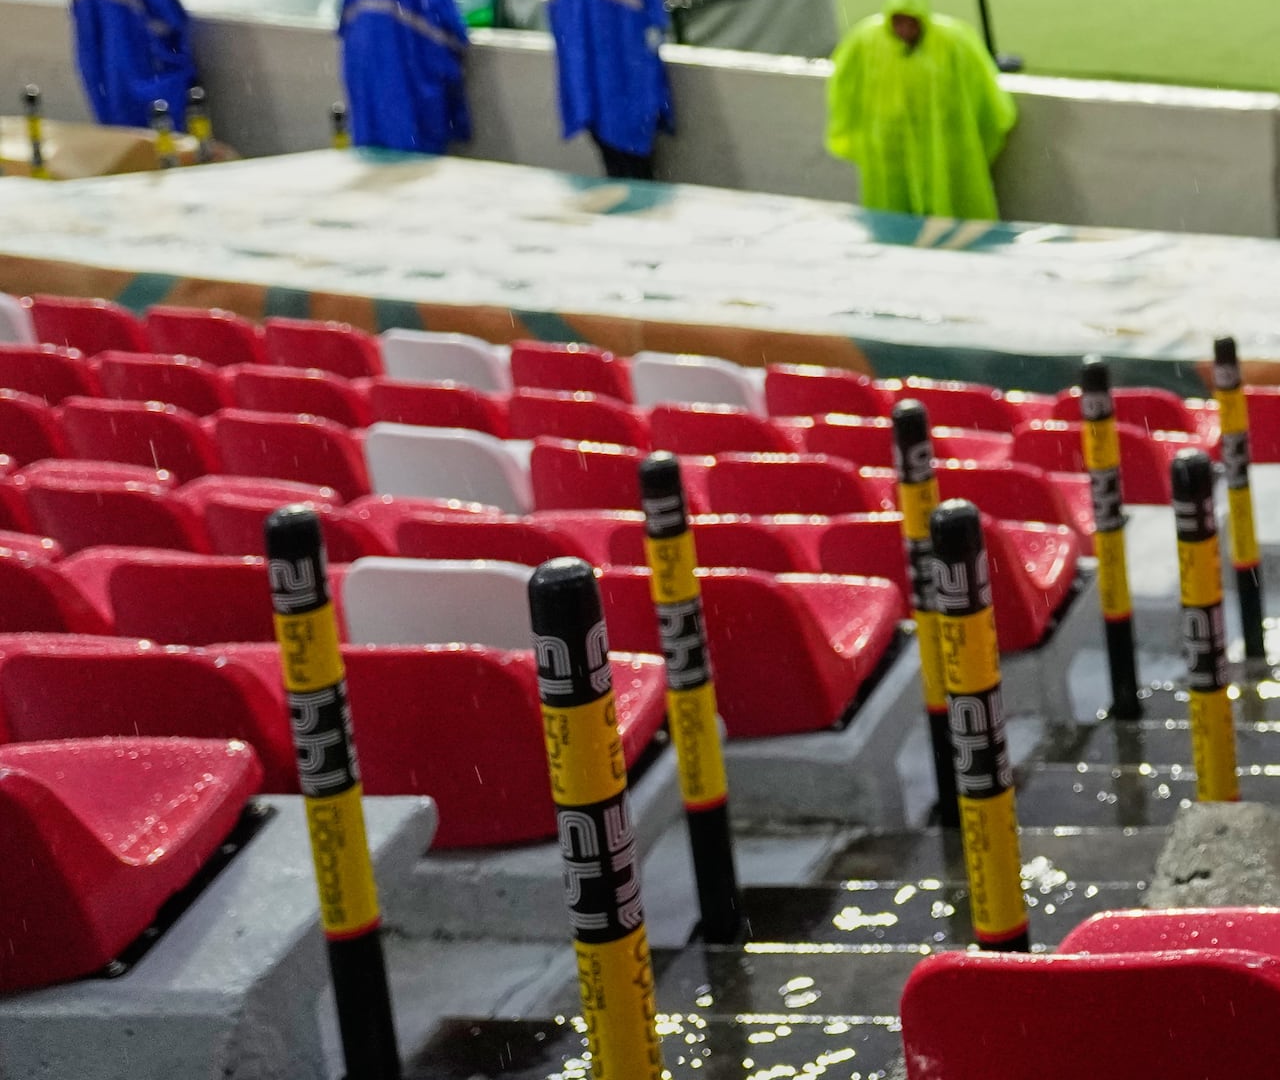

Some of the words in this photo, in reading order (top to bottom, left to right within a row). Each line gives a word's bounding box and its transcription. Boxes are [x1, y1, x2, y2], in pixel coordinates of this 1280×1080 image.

[644, 495, 681, 533] 11
[268, 557, 317, 614] 12
[929, 557, 970, 610] 12
[949, 695, 993, 796] 145
